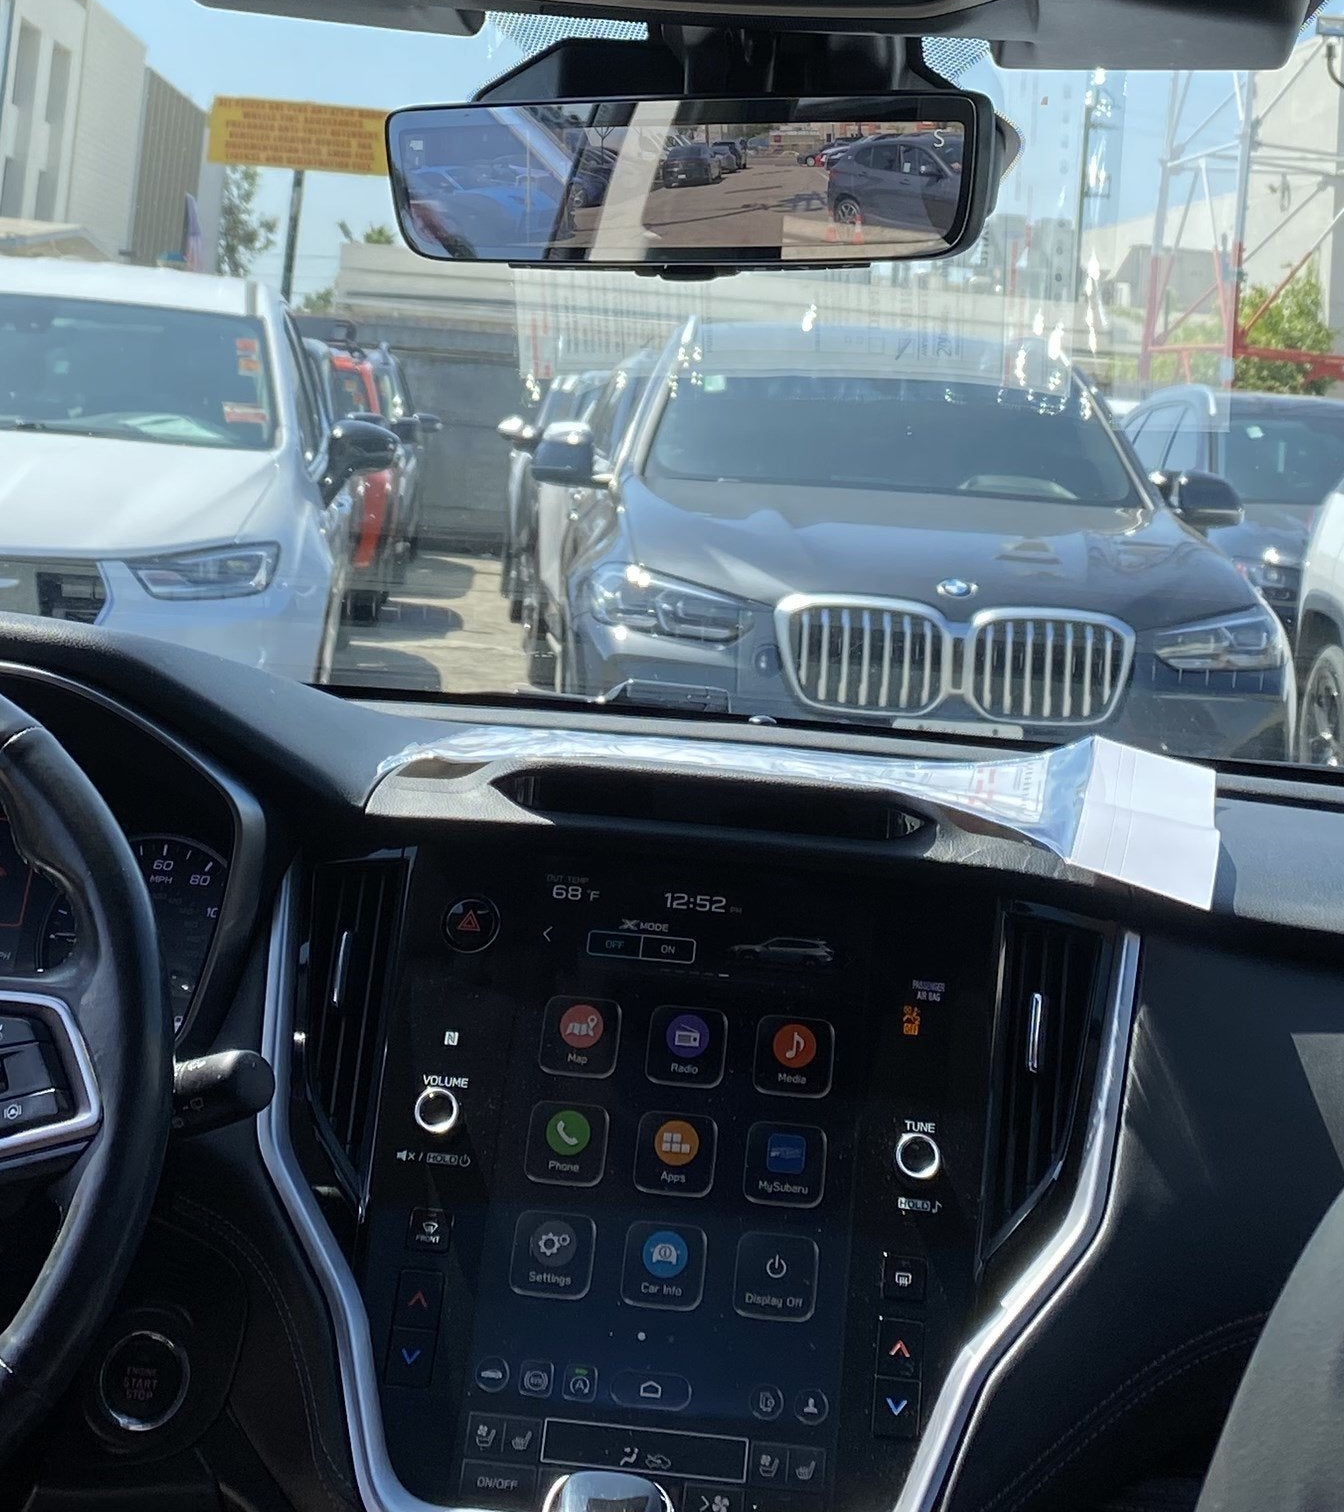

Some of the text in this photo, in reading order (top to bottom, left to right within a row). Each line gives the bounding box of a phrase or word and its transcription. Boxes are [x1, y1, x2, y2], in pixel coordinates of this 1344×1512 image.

[153, 859, 174, 871] 60
[149, 874, 173, 885] MPH
[189, 874, 211, 887] 80
[552, 884, 582, 901] 68
[663, 892, 727, 913] 12:52
[639, 921, 669, 933] MODE
[605, 939, 676, 955] OFF ON
[567, 1052, 588, 1066] Map
[671, 1062, 699, 1076] Radio
[422, 1074, 469, 1088] VOLUME
[777, 1072, 807, 1086] Media
[903, 1119, 936, 1133] TUNE
[426, 1152, 457, 1166] HOLD
[548, 1160, 580, 1173] Phone
[660, 1170, 686, 1185] Apps
[758, 1179, 809, 1195] MySubaru
[897, 1197, 931, 1212] HOLD
[528, 1270, 572, 1287] Settings
[640, 1281, 683, 1297] Car Info
[744, 1292, 804, 1309] Display Off
[123, 1376, 159, 1391] START
[125, 1388, 154, 1401] STOP
[476, 1477, 518, 1491] ON/OFF
